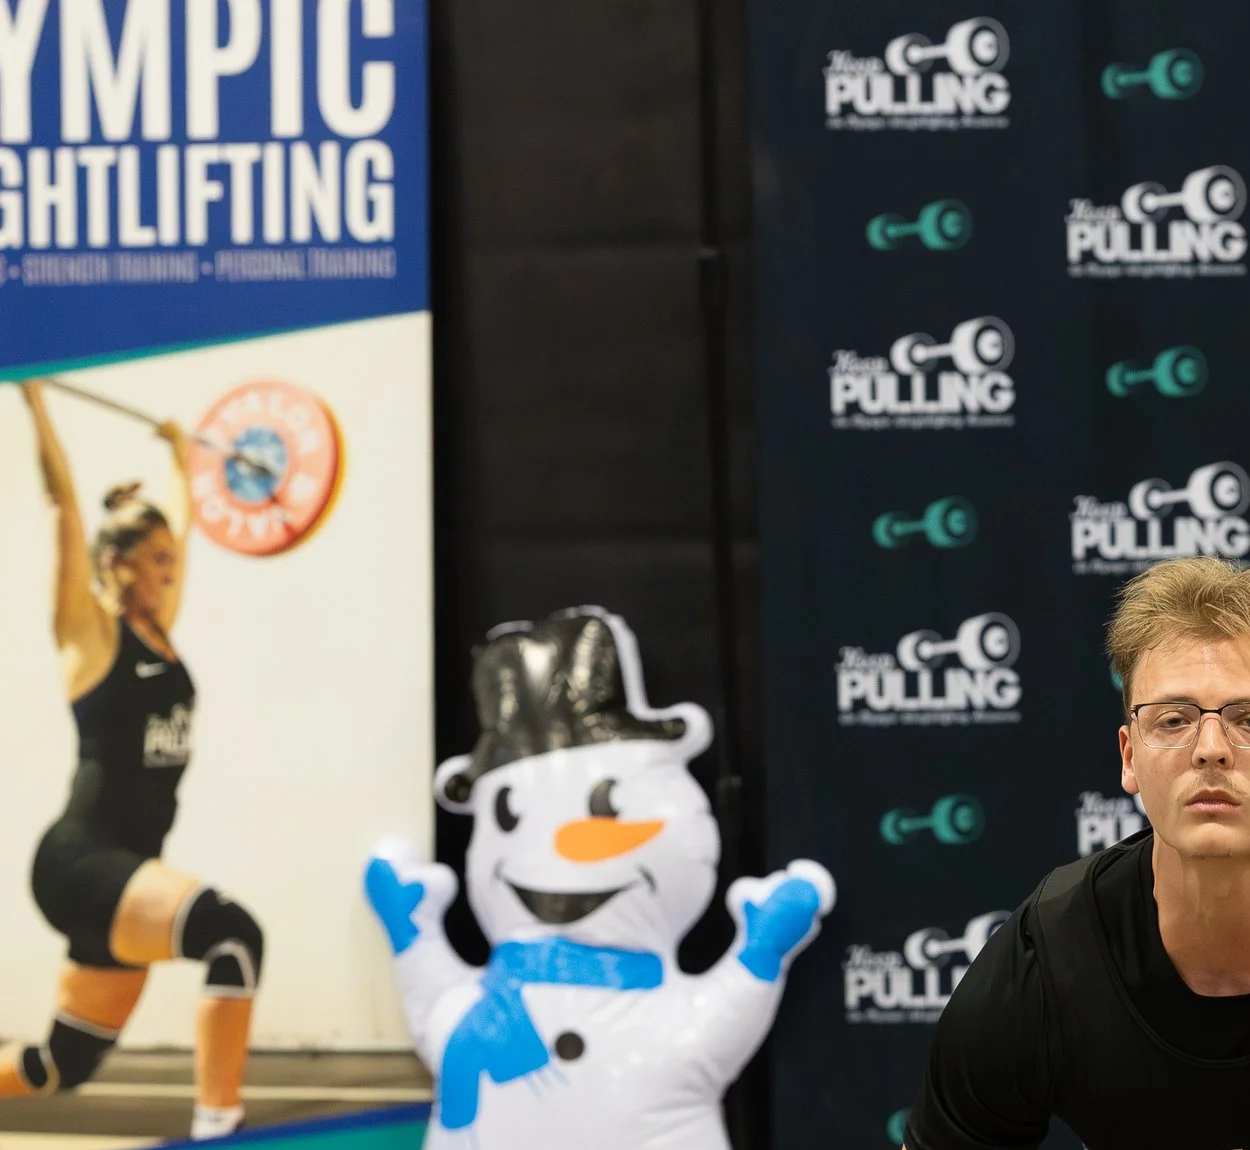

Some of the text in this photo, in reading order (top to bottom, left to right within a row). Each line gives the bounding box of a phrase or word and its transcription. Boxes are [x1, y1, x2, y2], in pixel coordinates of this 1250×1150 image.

[825, 72, 1010, 115] PULLING
[1064, 220, 1245, 263] PULLING
[830, 371, 1015, 414] PULLING
[1070, 517, 1250, 558] PULLING
[836, 668, 1021, 710] PULLING
[843, 963, 968, 1009] PULL
